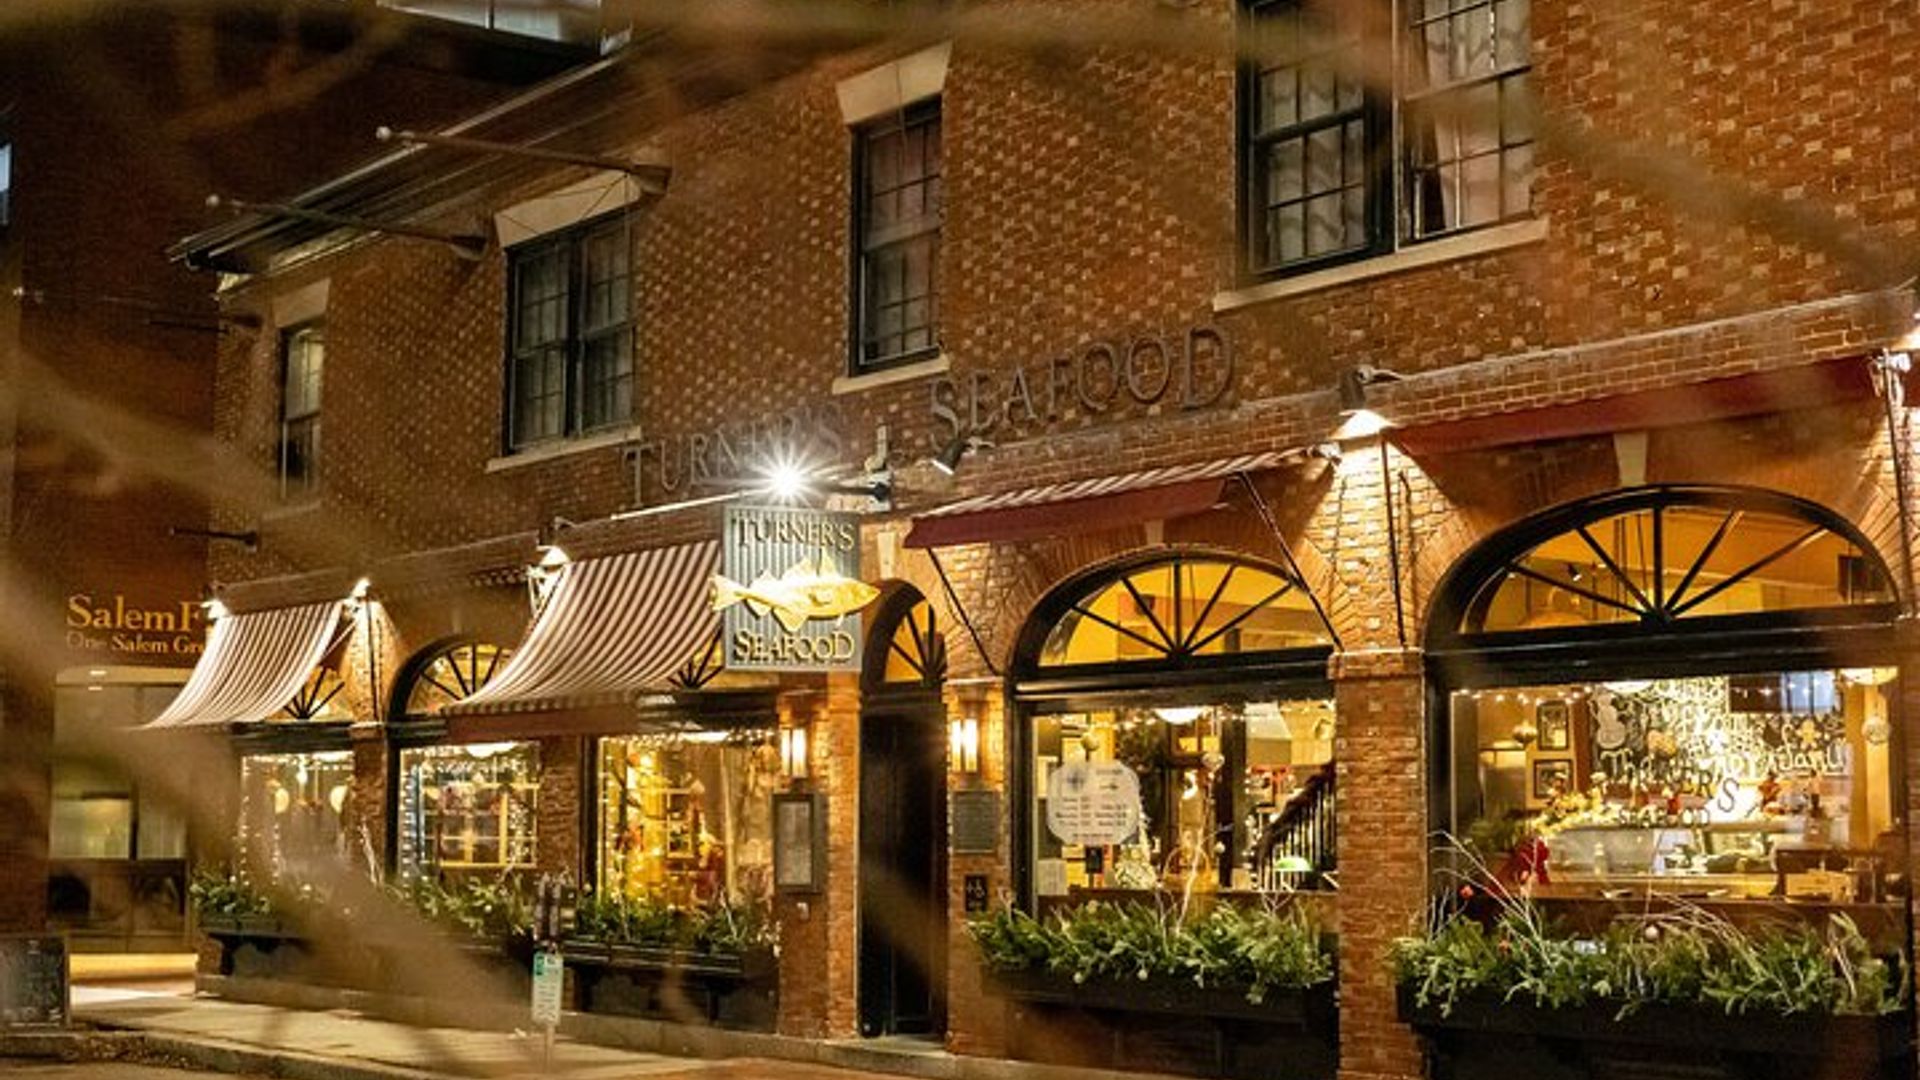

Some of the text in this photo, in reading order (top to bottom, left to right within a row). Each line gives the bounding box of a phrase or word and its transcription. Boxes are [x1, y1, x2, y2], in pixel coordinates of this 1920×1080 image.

[929, 324, 1235, 451] SEAFOOD
[734, 514, 855, 551] TURNER'S
[66, 594, 206, 631] SalemF
[111, 632, 168, 653] Salem
[733, 627, 856, 662] SEAFOOD
